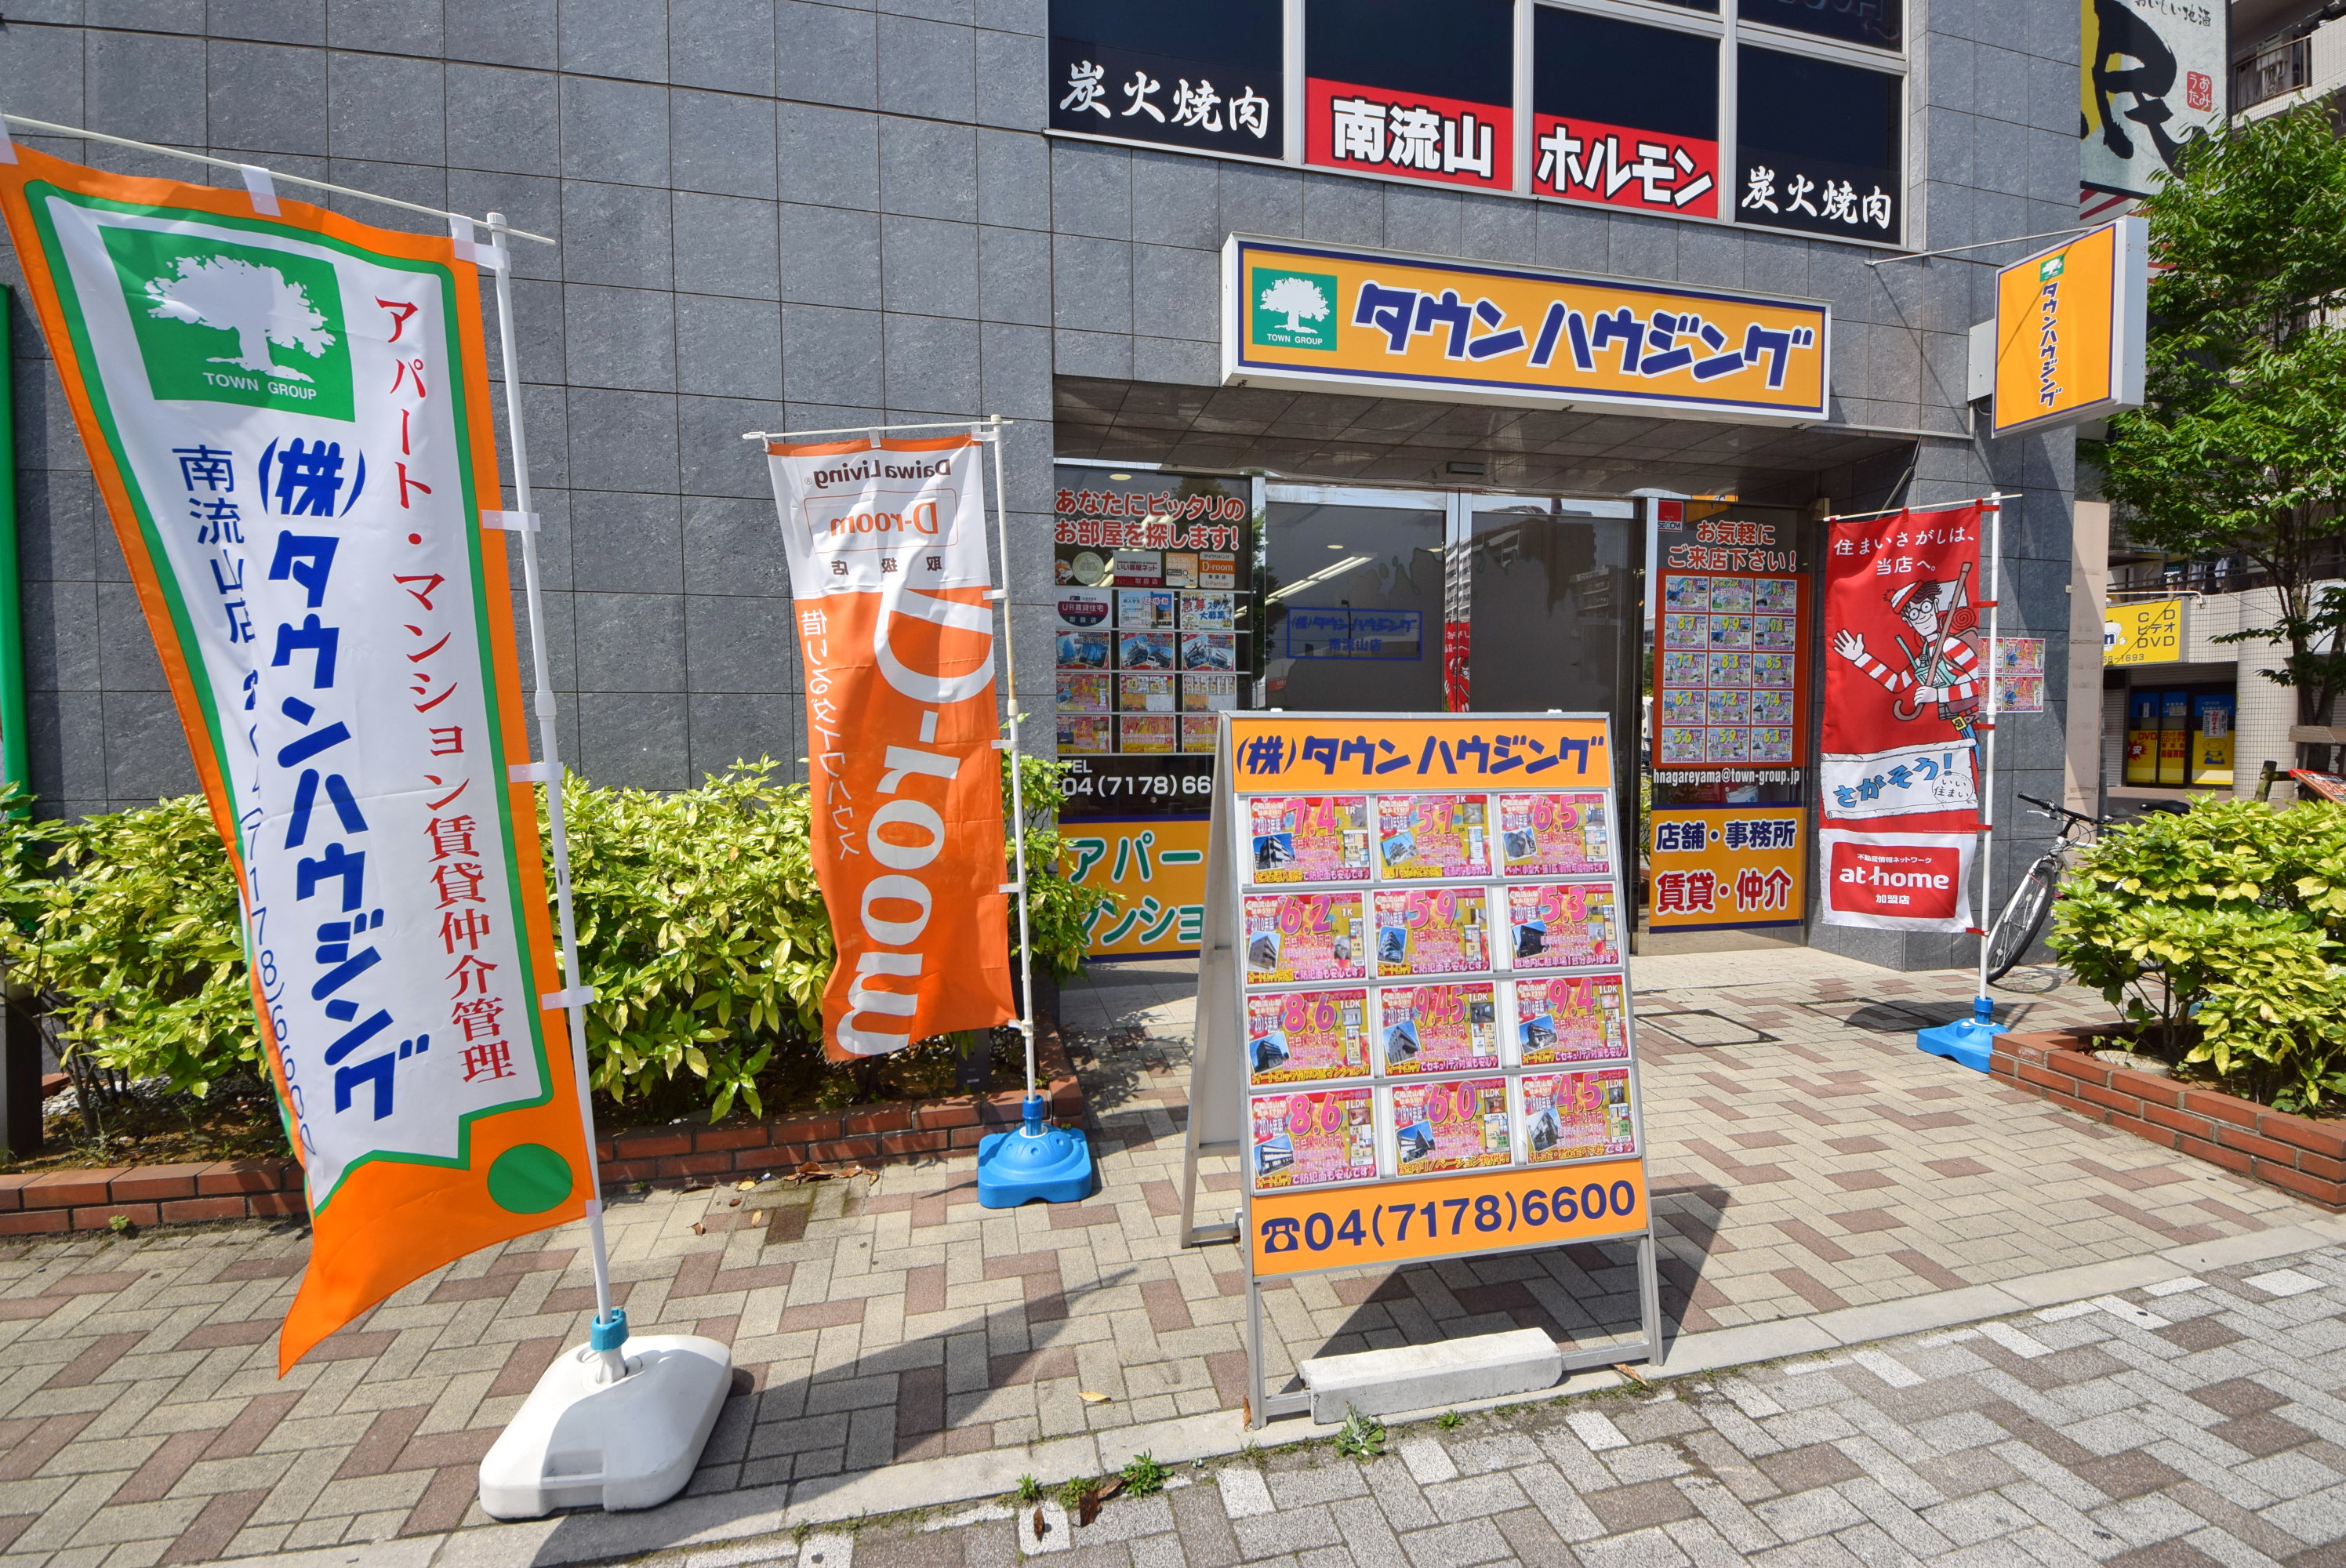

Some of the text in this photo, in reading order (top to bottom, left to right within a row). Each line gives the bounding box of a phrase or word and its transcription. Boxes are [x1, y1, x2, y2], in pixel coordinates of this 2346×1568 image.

[1059, 60, 1269, 139] 炭火焼肉
[1332, 99, 1492, 179] 南流山
[1536, 125, 1713, 209] ホルモン
[1742, 165, 1891, 230] 炭火焼肉
[1266, 332, 1324, 347] TOWN GROUP
[1351, 279, 1815, 390] タウンハウジング
[2039, 281, 2063, 408] タウンハウジング
[202, 371, 318, 401] TOWN GROUP
[1055, 488, 1245, 521] あなたにピッタリの
[1055, 518, 1240, 550] お部屋を探します!
[1658, 521, 1681, 530] SECOM
[1696, 520, 1776, 546] お気軽に
[1202, 561, 1233, 572] D-room
[1668, 543, 1797, 572] ご来店下さい!
[1876, 555, 1936, 575] 当店へ。
[1062, 604, 1104, 612] UR賃貸住宅
[2137, 622, 2176, 636] ビデオ
[2137, 636, 2175, 648] DVD
[375, 296, 517, 1083] アパート・マンション賃貸仲介管理
[1832, 753, 1952, 808] さがそう!
[1934, 786, 1970, 798] 住まい
[1284, 797, 1338, 837] 7.4
[1418, 803, 1454, 834] 5.7
[1532, 794, 1579, 832] 6.5
[1654, 819, 1797, 852] 店舗・事務所
[1857, 853, 1933, 864] 不動産情報ネットワーク
[1542, 885, 1588, 923] 5.3
[1655, 866, 1794, 915] 賃貸・仲介
[1875, 894, 1911, 906] 加盟店
[1280, 894, 1331, 935] 6.2
[1342, 908, 1353, 916] 1K
[1408, 890, 1457, 929] 5.9
[1341, 1000, 1360, 1008] 1LDK
[1414, 985, 1465, 1026] 9.45
[1469, 993, 1487, 1002] 1LDK
[1549, 978, 1596, 1016] 9.4
[1599, 985, 1617, 994] 1LDK
[1284, 993, 1337, 1033] 8.6
[1480, 1088, 1500, 1098] 1LDK
[1556, 1072, 1603, 1112] 4.5
[1605, 1080, 1624, 1089] 1LDK
[1289, 1092, 1342, 1135] 8.6
[1346, 1100, 1366, 1109] 1LDK
[1428, 1080, 1477, 1123] 6.0
[1305, 1180, 1636, 1251] 04(7178)6600
